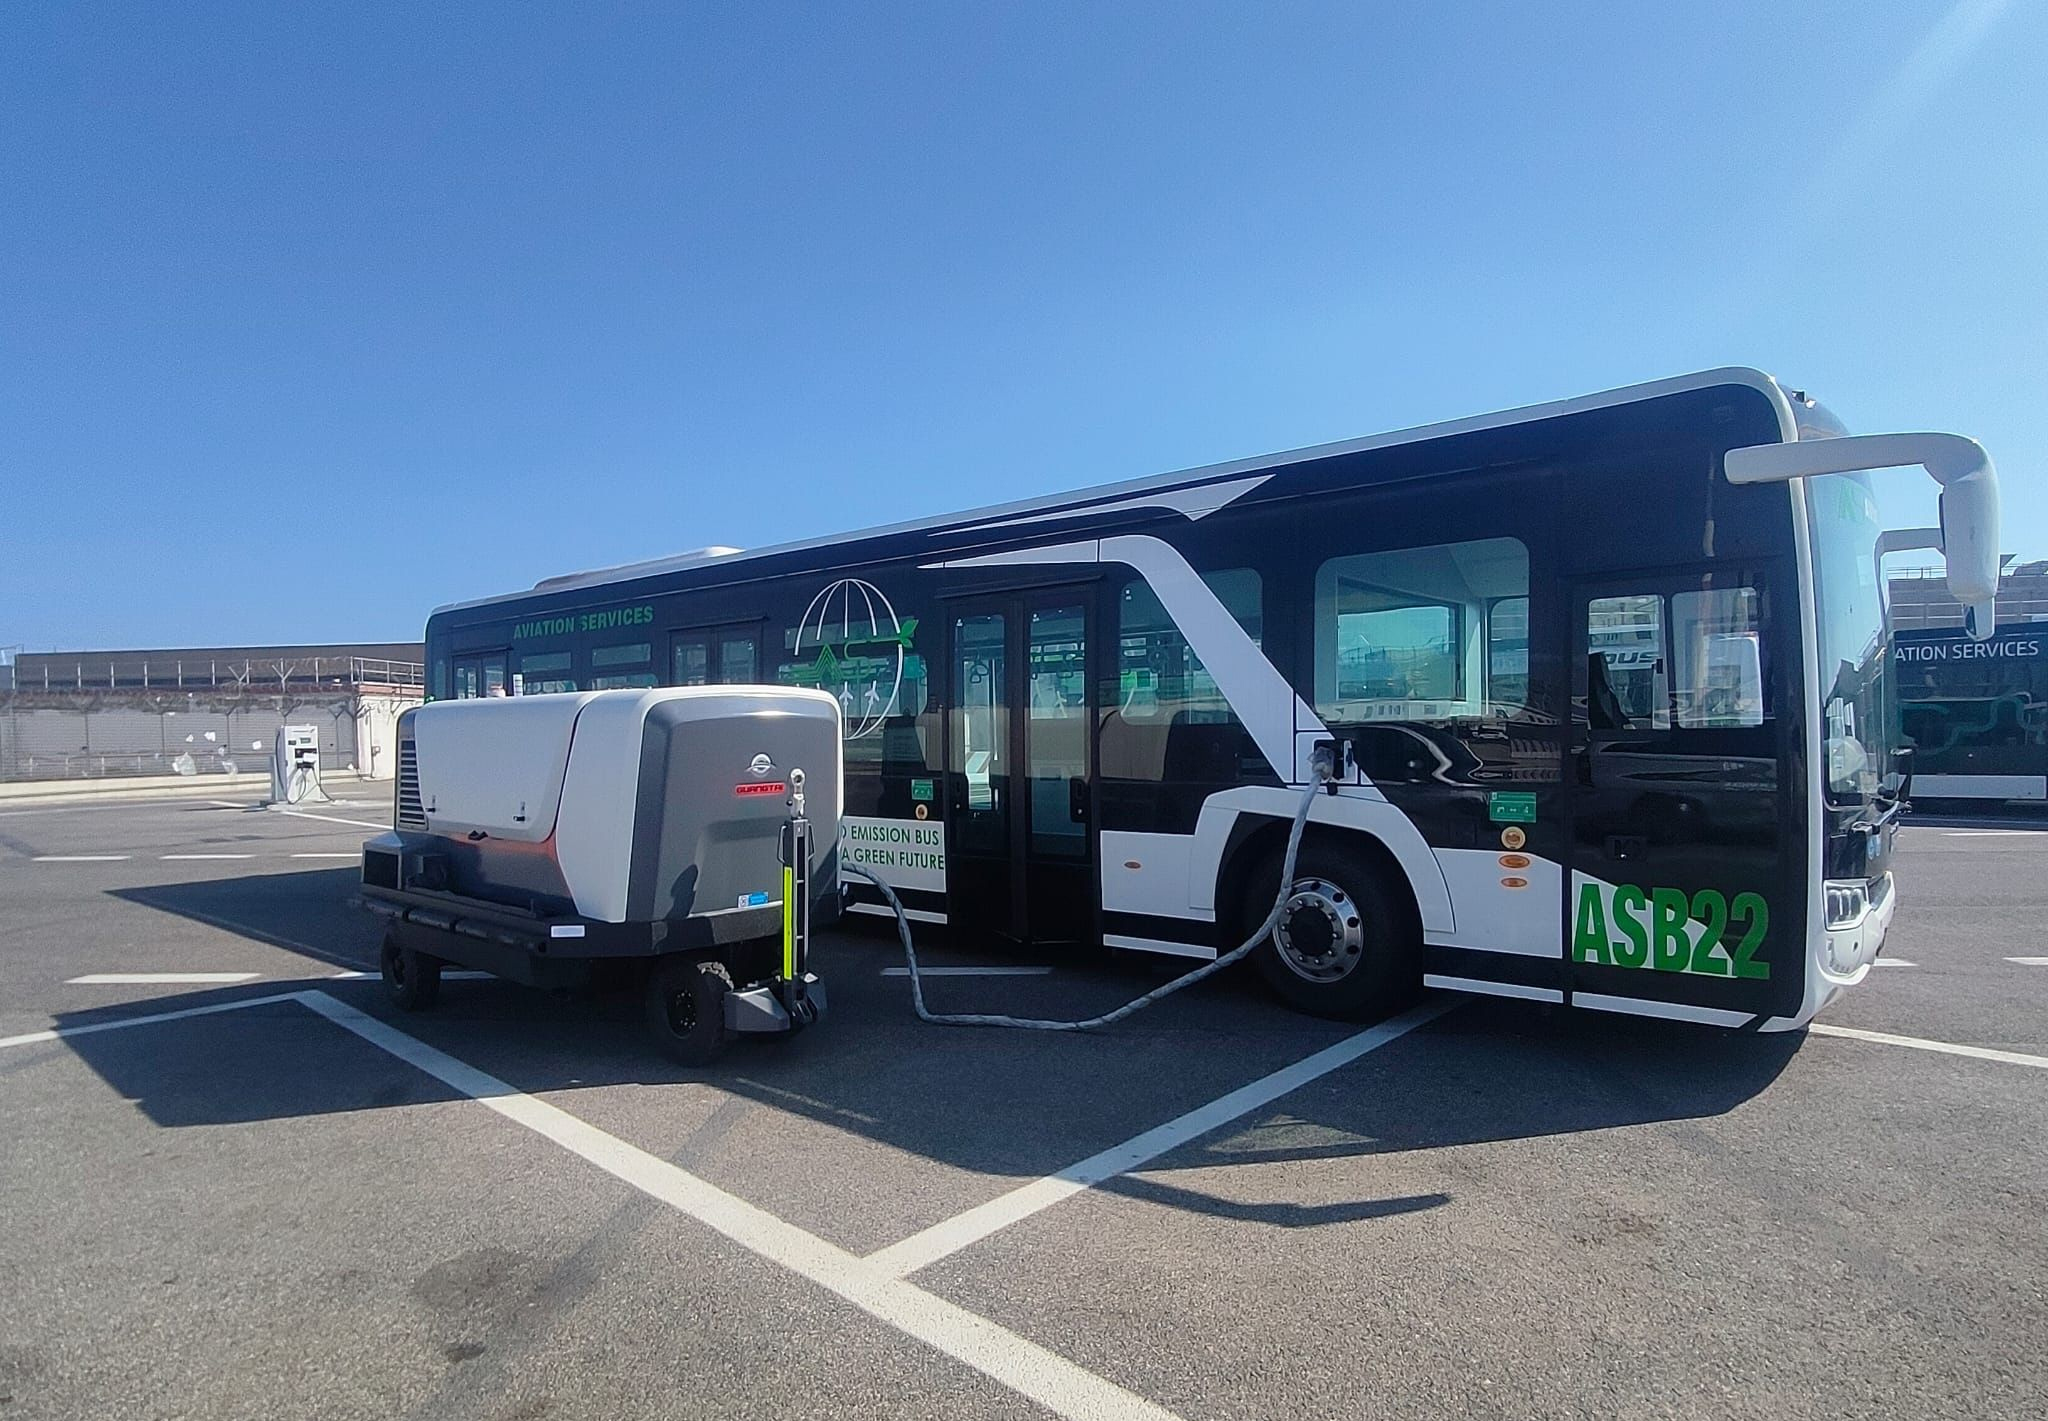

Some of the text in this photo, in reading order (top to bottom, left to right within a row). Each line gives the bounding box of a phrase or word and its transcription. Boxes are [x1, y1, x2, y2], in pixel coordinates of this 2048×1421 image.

[513, 606, 654, 639] AVIATION SERVICES
[1952, 641, 2039, 659] SERVICES
[851, 825, 910, 844] EMISSION
[915, 829, 939, 846] BUS
[842, 847, 945, 870] A GREEN FUTURE
[1572, 883, 1770, 980] ASB22
